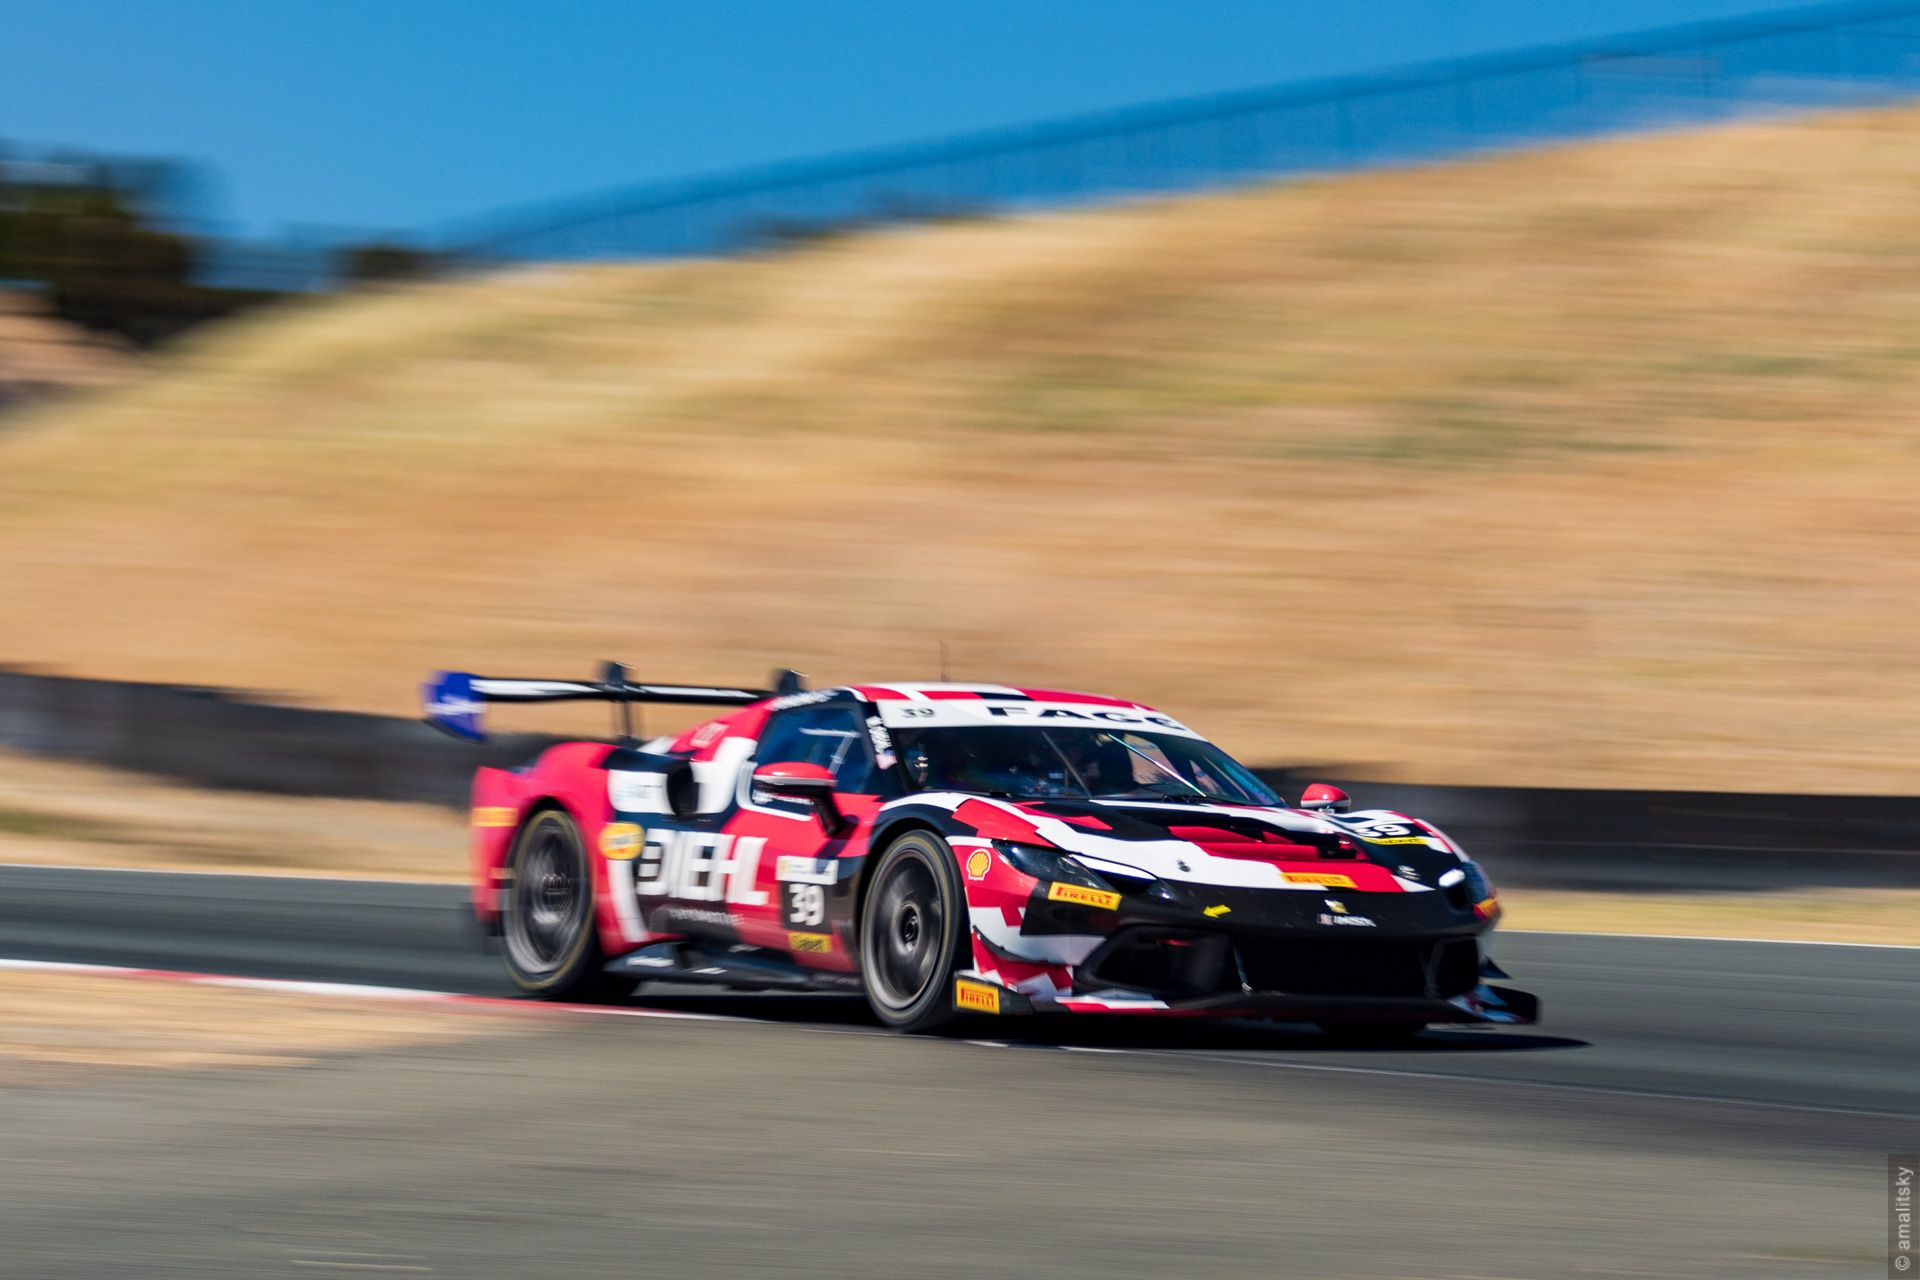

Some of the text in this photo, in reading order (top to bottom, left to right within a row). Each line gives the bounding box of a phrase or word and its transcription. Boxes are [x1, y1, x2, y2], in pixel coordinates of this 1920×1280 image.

[636, 828, 769, 906] DIEHL
[788, 883, 825, 927] 39
[1055, 886, 1113, 906] PIRELLI
[960, 987, 995, 1009] PIRELLI
